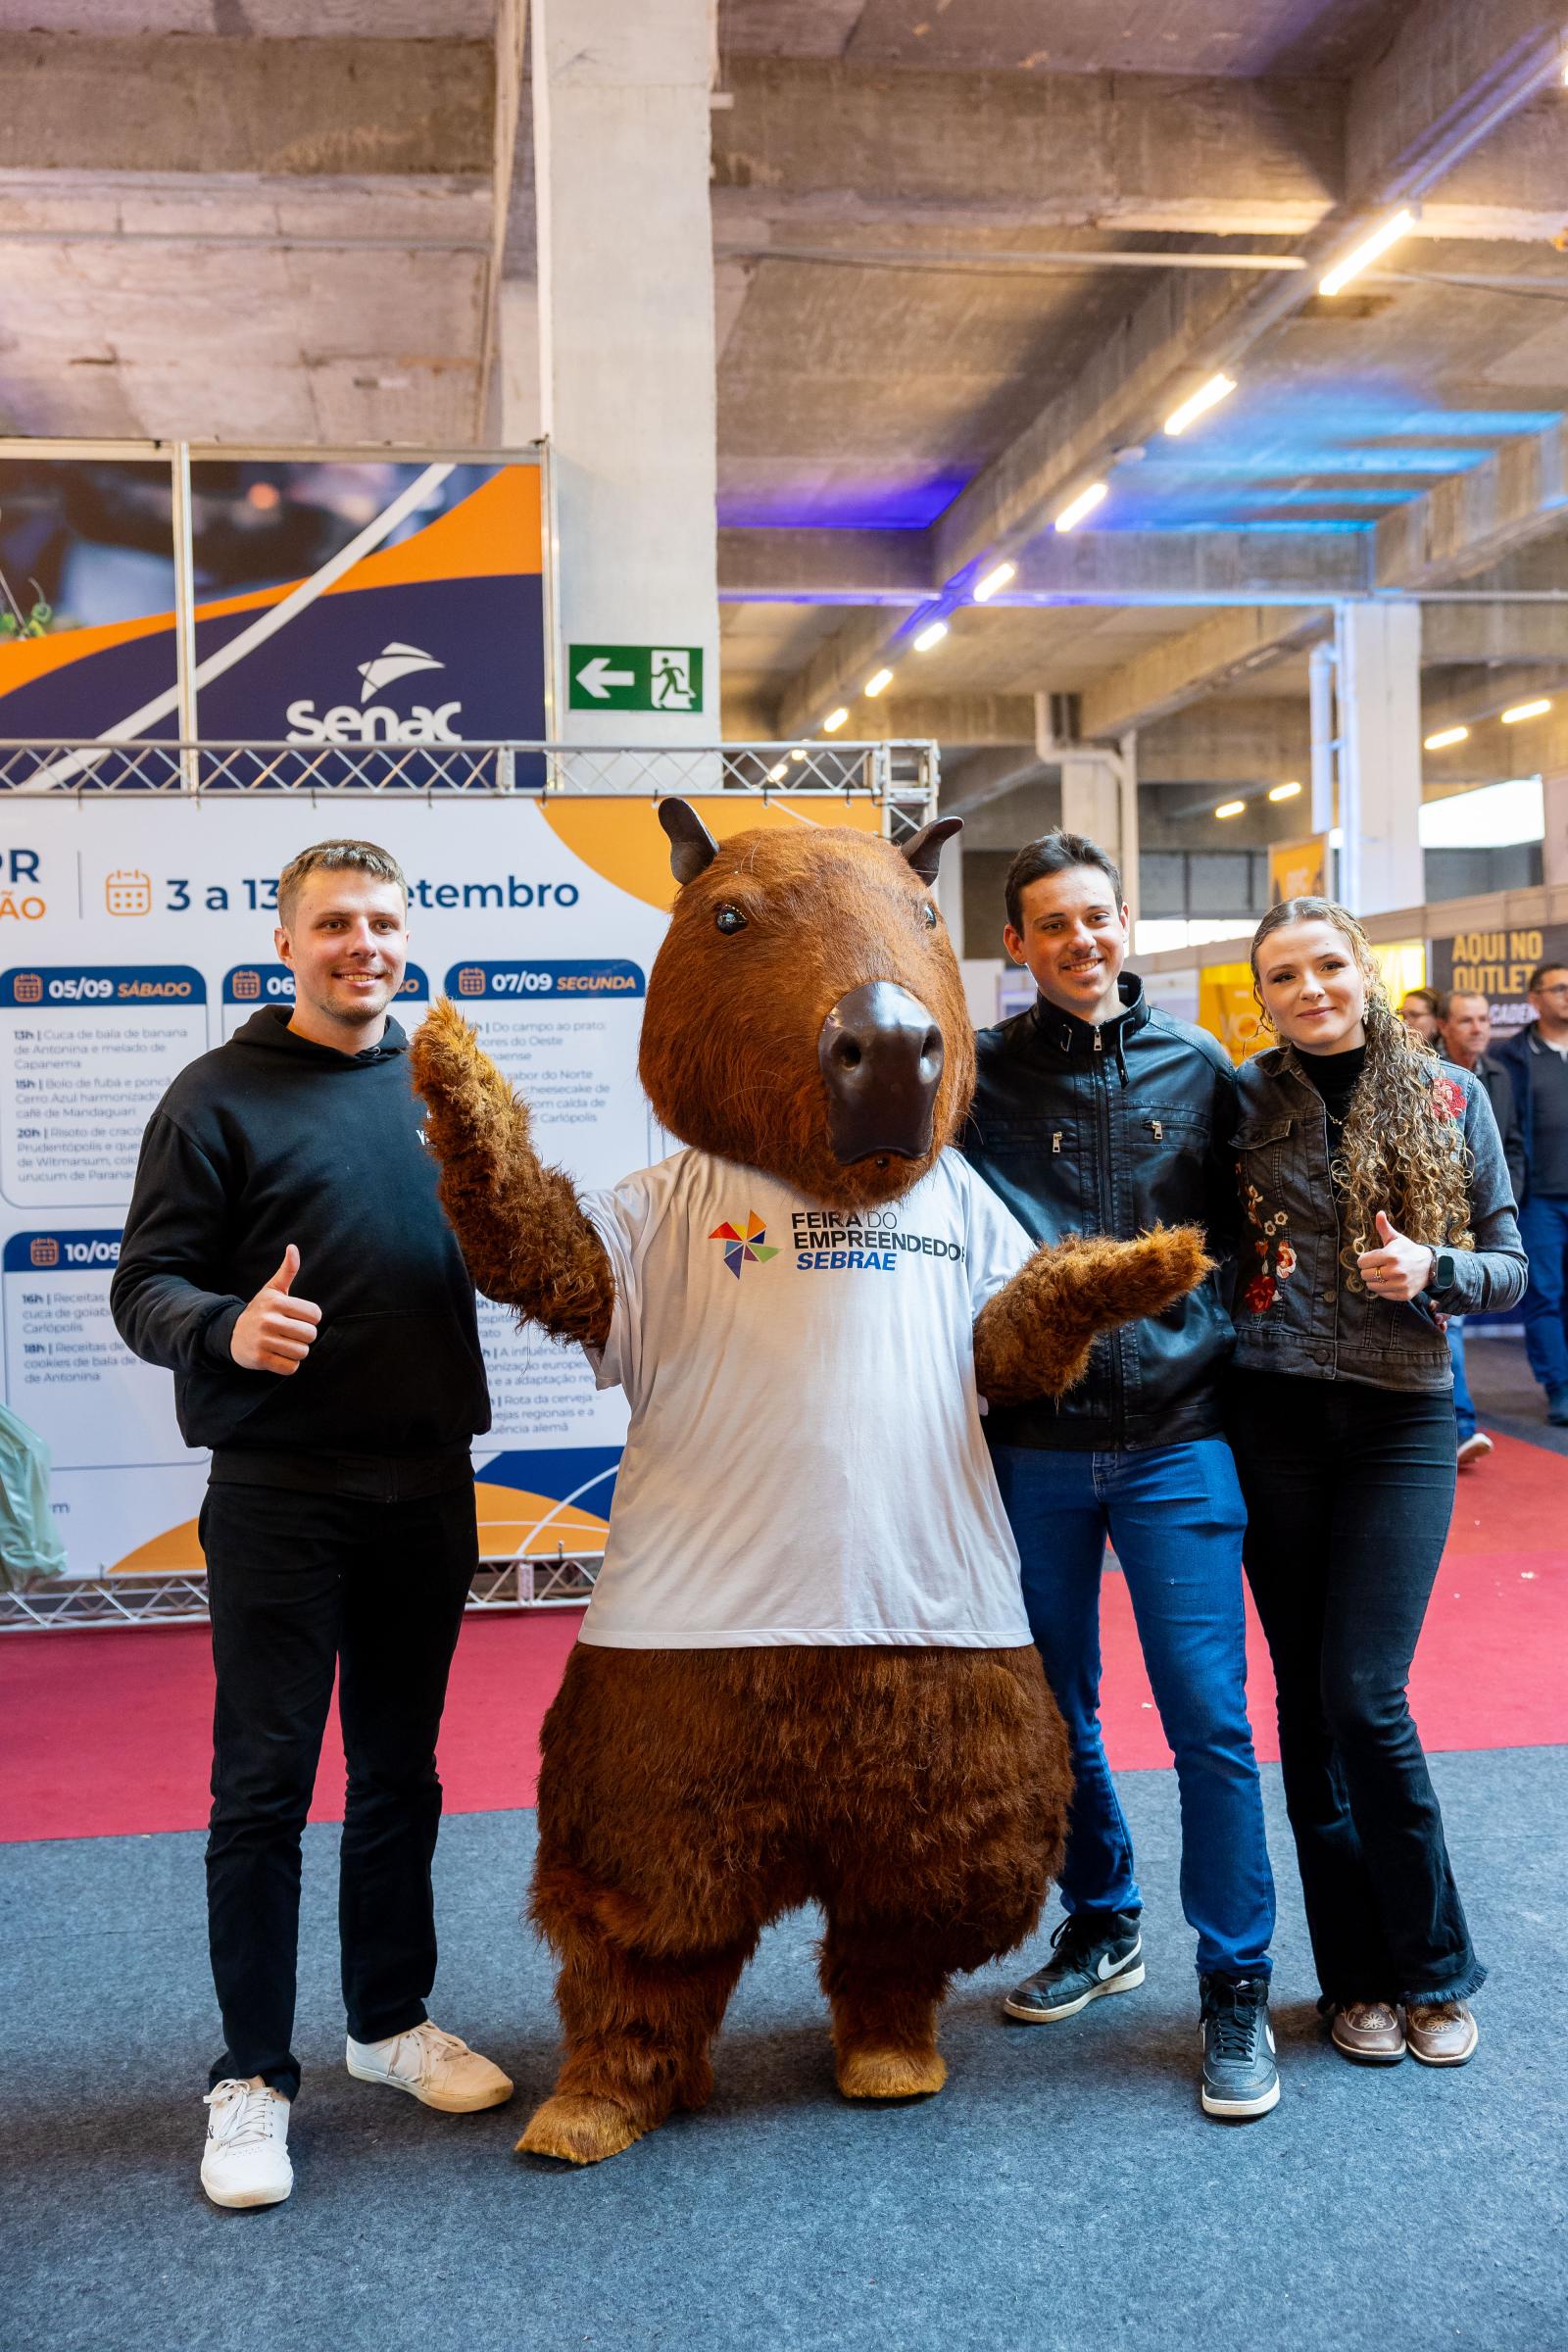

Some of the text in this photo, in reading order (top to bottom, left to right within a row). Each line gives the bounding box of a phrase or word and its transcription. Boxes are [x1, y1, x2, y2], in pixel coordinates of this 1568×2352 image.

[0, 849, 40, 883] R
[167, 880, 191, 911] 3
[206, 886, 229, 911] a
[406, 875, 580, 909] etembro
[1451, 930, 1544, 964] AQUI NO
[492, 972, 637, 994] 07/09 SEGUNDA
[1452, 963, 1538, 995] OUTLET
[49, 977, 192, 1000] 05/09 SÁBADO
[492, 1022, 510, 1032] Do
[513, 1022, 554, 1033] campo
[557, 1022, 570, 1031] ao
[43, 1030, 74, 1041] Cuca
[77, 1029, 93, 1040] de
[97, 1029, 121, 1039] bala
[123, 1028, 139, 1039] de
[142, 1028, 187, 1039] banana
[511, 1036, 526, 1047] do
[529, 1035, 564, 1046] Oeste
[14, 1045, 29, 1055] de
[32, 1044, 88, 1054] Antonina
[102, 1043, 147, 1054] melado
[151, 1042, 166, 1053] de
[15, 1058, 81, 1071] Capanema
[542, 1068, 558, 1079] do
[560, 1067, 594, 1079] Norte
[45, 1079, 73, 1089] Bolo
[77, 1078, 92, 1088] de
[595, 1083, 611, 1094] de
[15, 1093, 48, 1103] Cerro
[51, 1093, 76, 1103] Azul
[557, 1097, 588, 1108] calda
[590, 1097, 606, 1107] de
[44, 1107, 59, 1118] de
[63, 1106, 136, 1119] Mandaguari
[541, 1111, 597, 1124] Carlópolis
[50, 1127, 87, 1138] Risoto
[91, 1126, 106, 1137] de
[18, 1156, 32, 1167] de
[18, 1172, 71, 1182] urucum
[72, 1170, 85, 1180] de
[792, 1211, 898, 1230] FEIRA DO
[64, 1240, 121, 1263] 10/09
[796, 1251, 897, 1271] SEBRAE
[54, 1292, 105, 1303] Receitas
[23, 1309, 52, 1319] cuca
[55, 1308, 71, 1318] de
[23, 1323, 83, 1335] Carlópolis
[55, 1342, 106, 1353] Receitas
[110, 1342, 124, 1351] de
[24, 1355, 136, 1368] cookies de bala de
[24, 1372, 101, 1384] de Antonina
[514, 1375, 576, 1388] adaptação
[505, 1395, 530, 1404] Rota
[533, 1394, 549, 1404] da
[552, 1394, 592, 1404] cerveja
[521, 1407, 575, 1419] regionais
[587, 1408, 595, 1417] a
